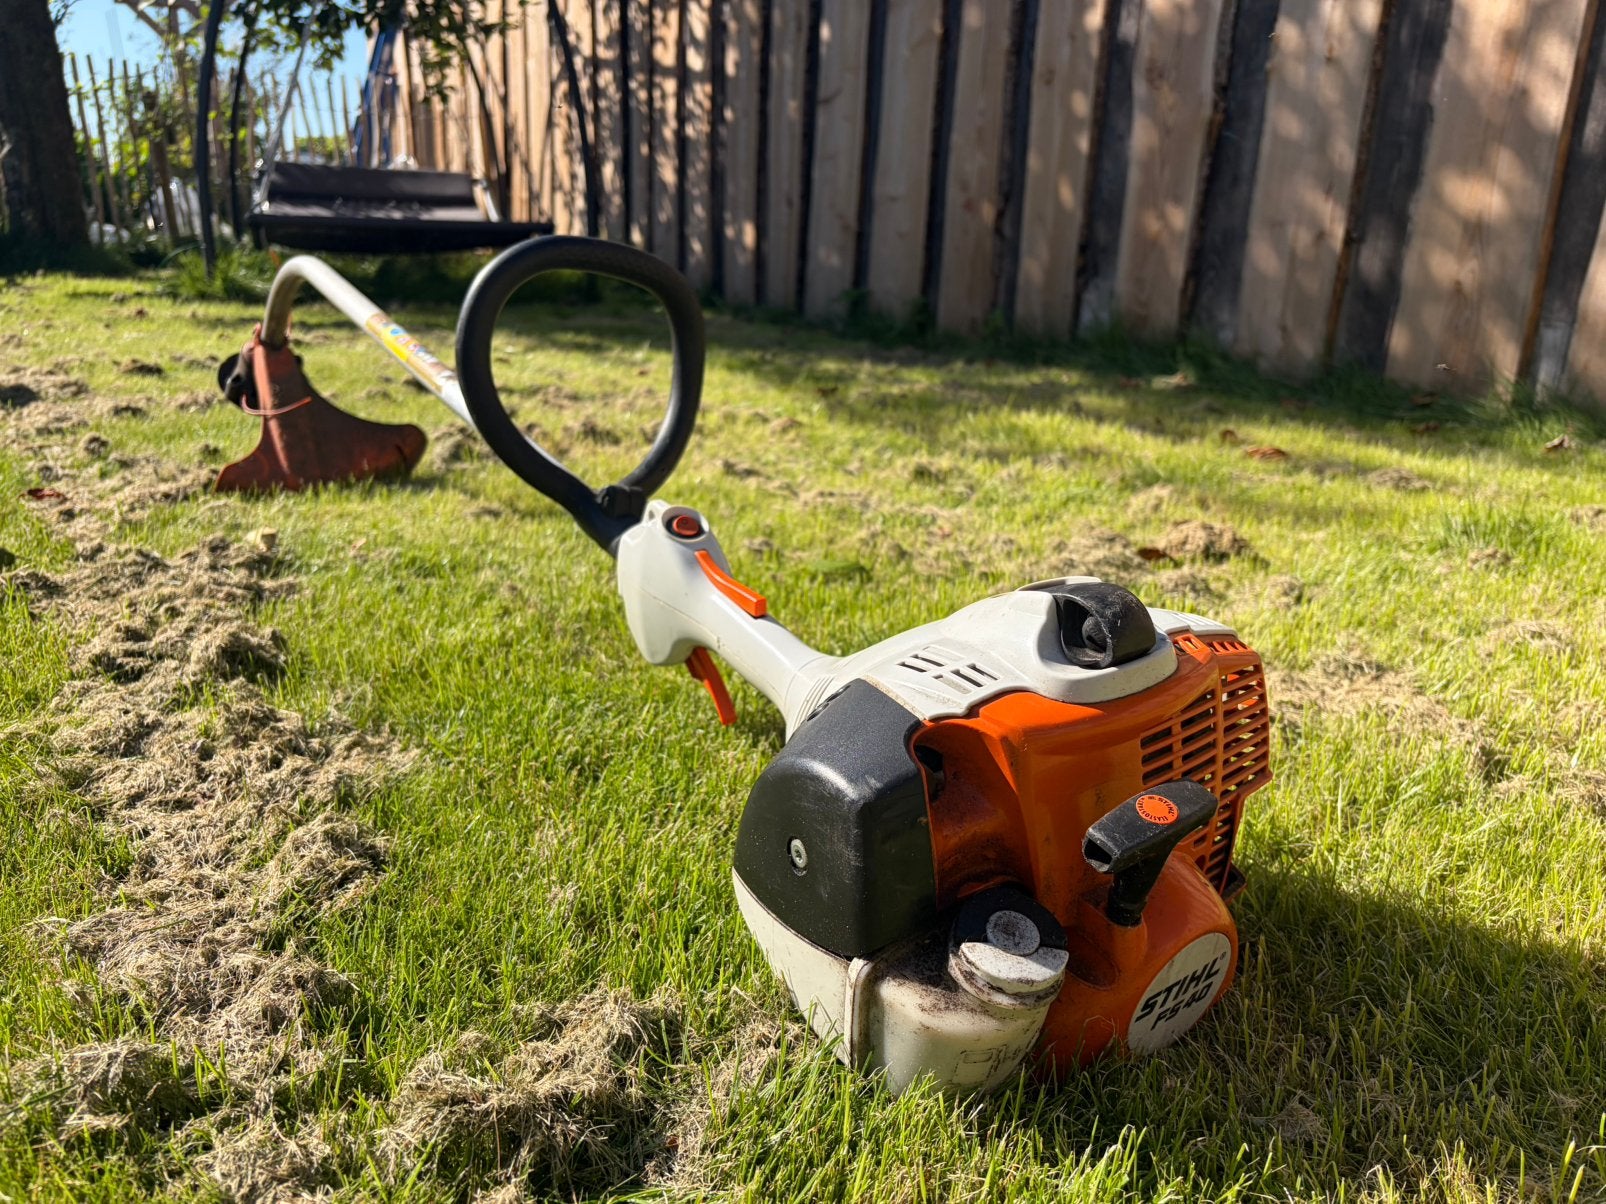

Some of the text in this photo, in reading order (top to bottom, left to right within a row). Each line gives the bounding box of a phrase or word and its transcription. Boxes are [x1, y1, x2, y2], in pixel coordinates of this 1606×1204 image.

[1134, 956, 1221, 1023] STIHL
[1150, 981, 1213, 1031] FS 40
